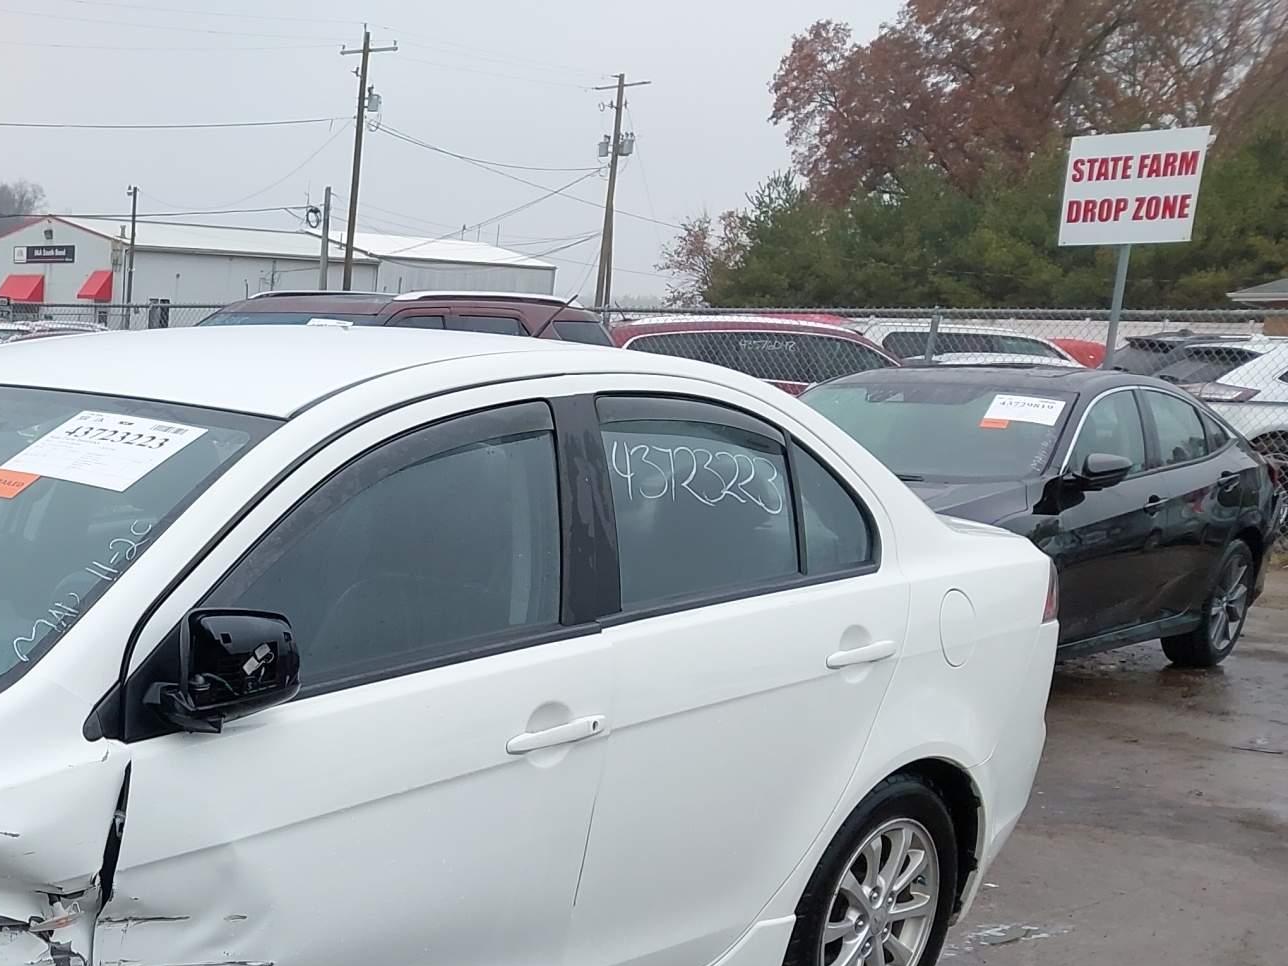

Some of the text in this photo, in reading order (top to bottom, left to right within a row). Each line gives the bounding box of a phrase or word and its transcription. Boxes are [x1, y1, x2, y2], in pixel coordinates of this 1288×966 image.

[1072, 150, 1200, 182] STATE FARM
[1066, 193, 1193, 223] DROP ZONE
[65, 425, 170, 449] 43723223
[611, 441, 783, 515] 43723223
